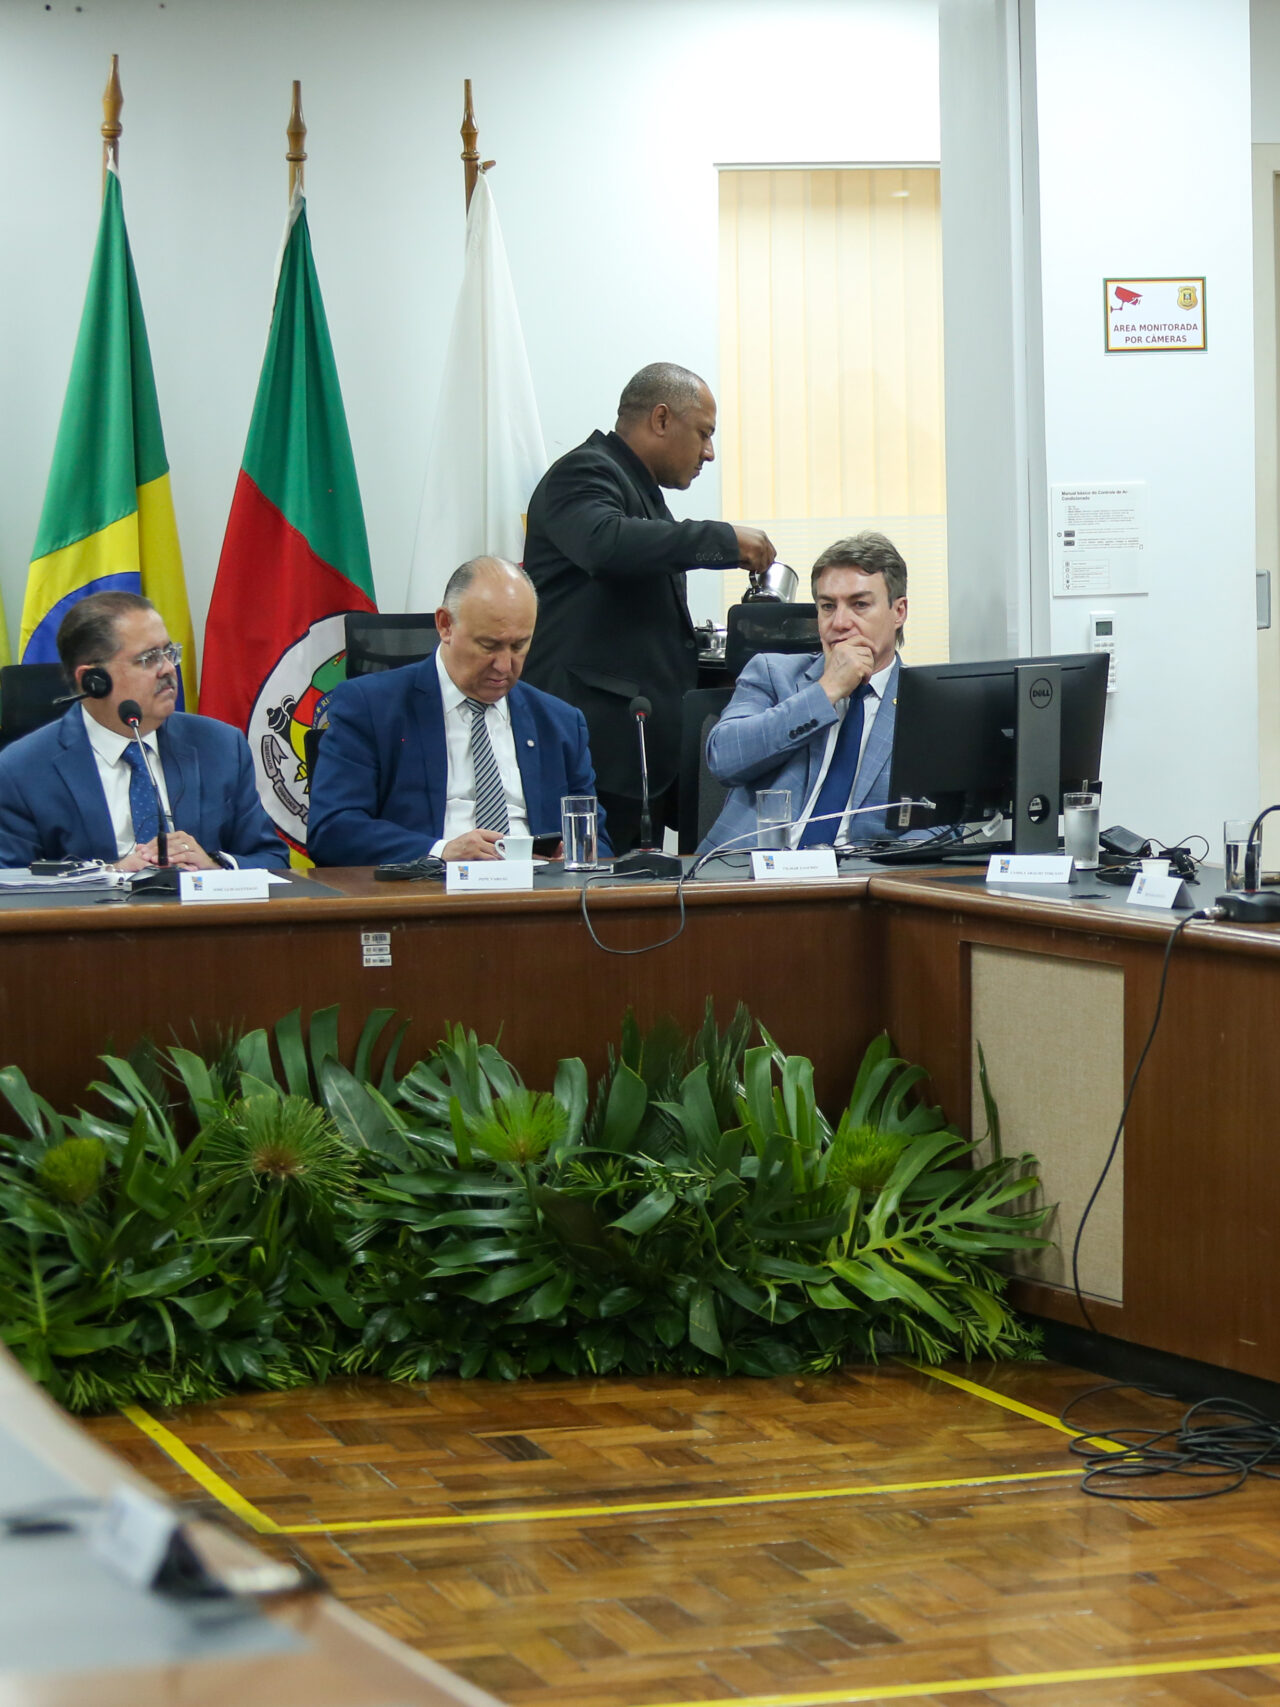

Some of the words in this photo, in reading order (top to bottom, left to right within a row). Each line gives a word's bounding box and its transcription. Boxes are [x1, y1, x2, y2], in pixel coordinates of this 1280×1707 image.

[1139, 323, 1198, 332] MONITORADA
[1124, 335, 1143, 344] POR
[1032, 689, 1050, 698] DELL
